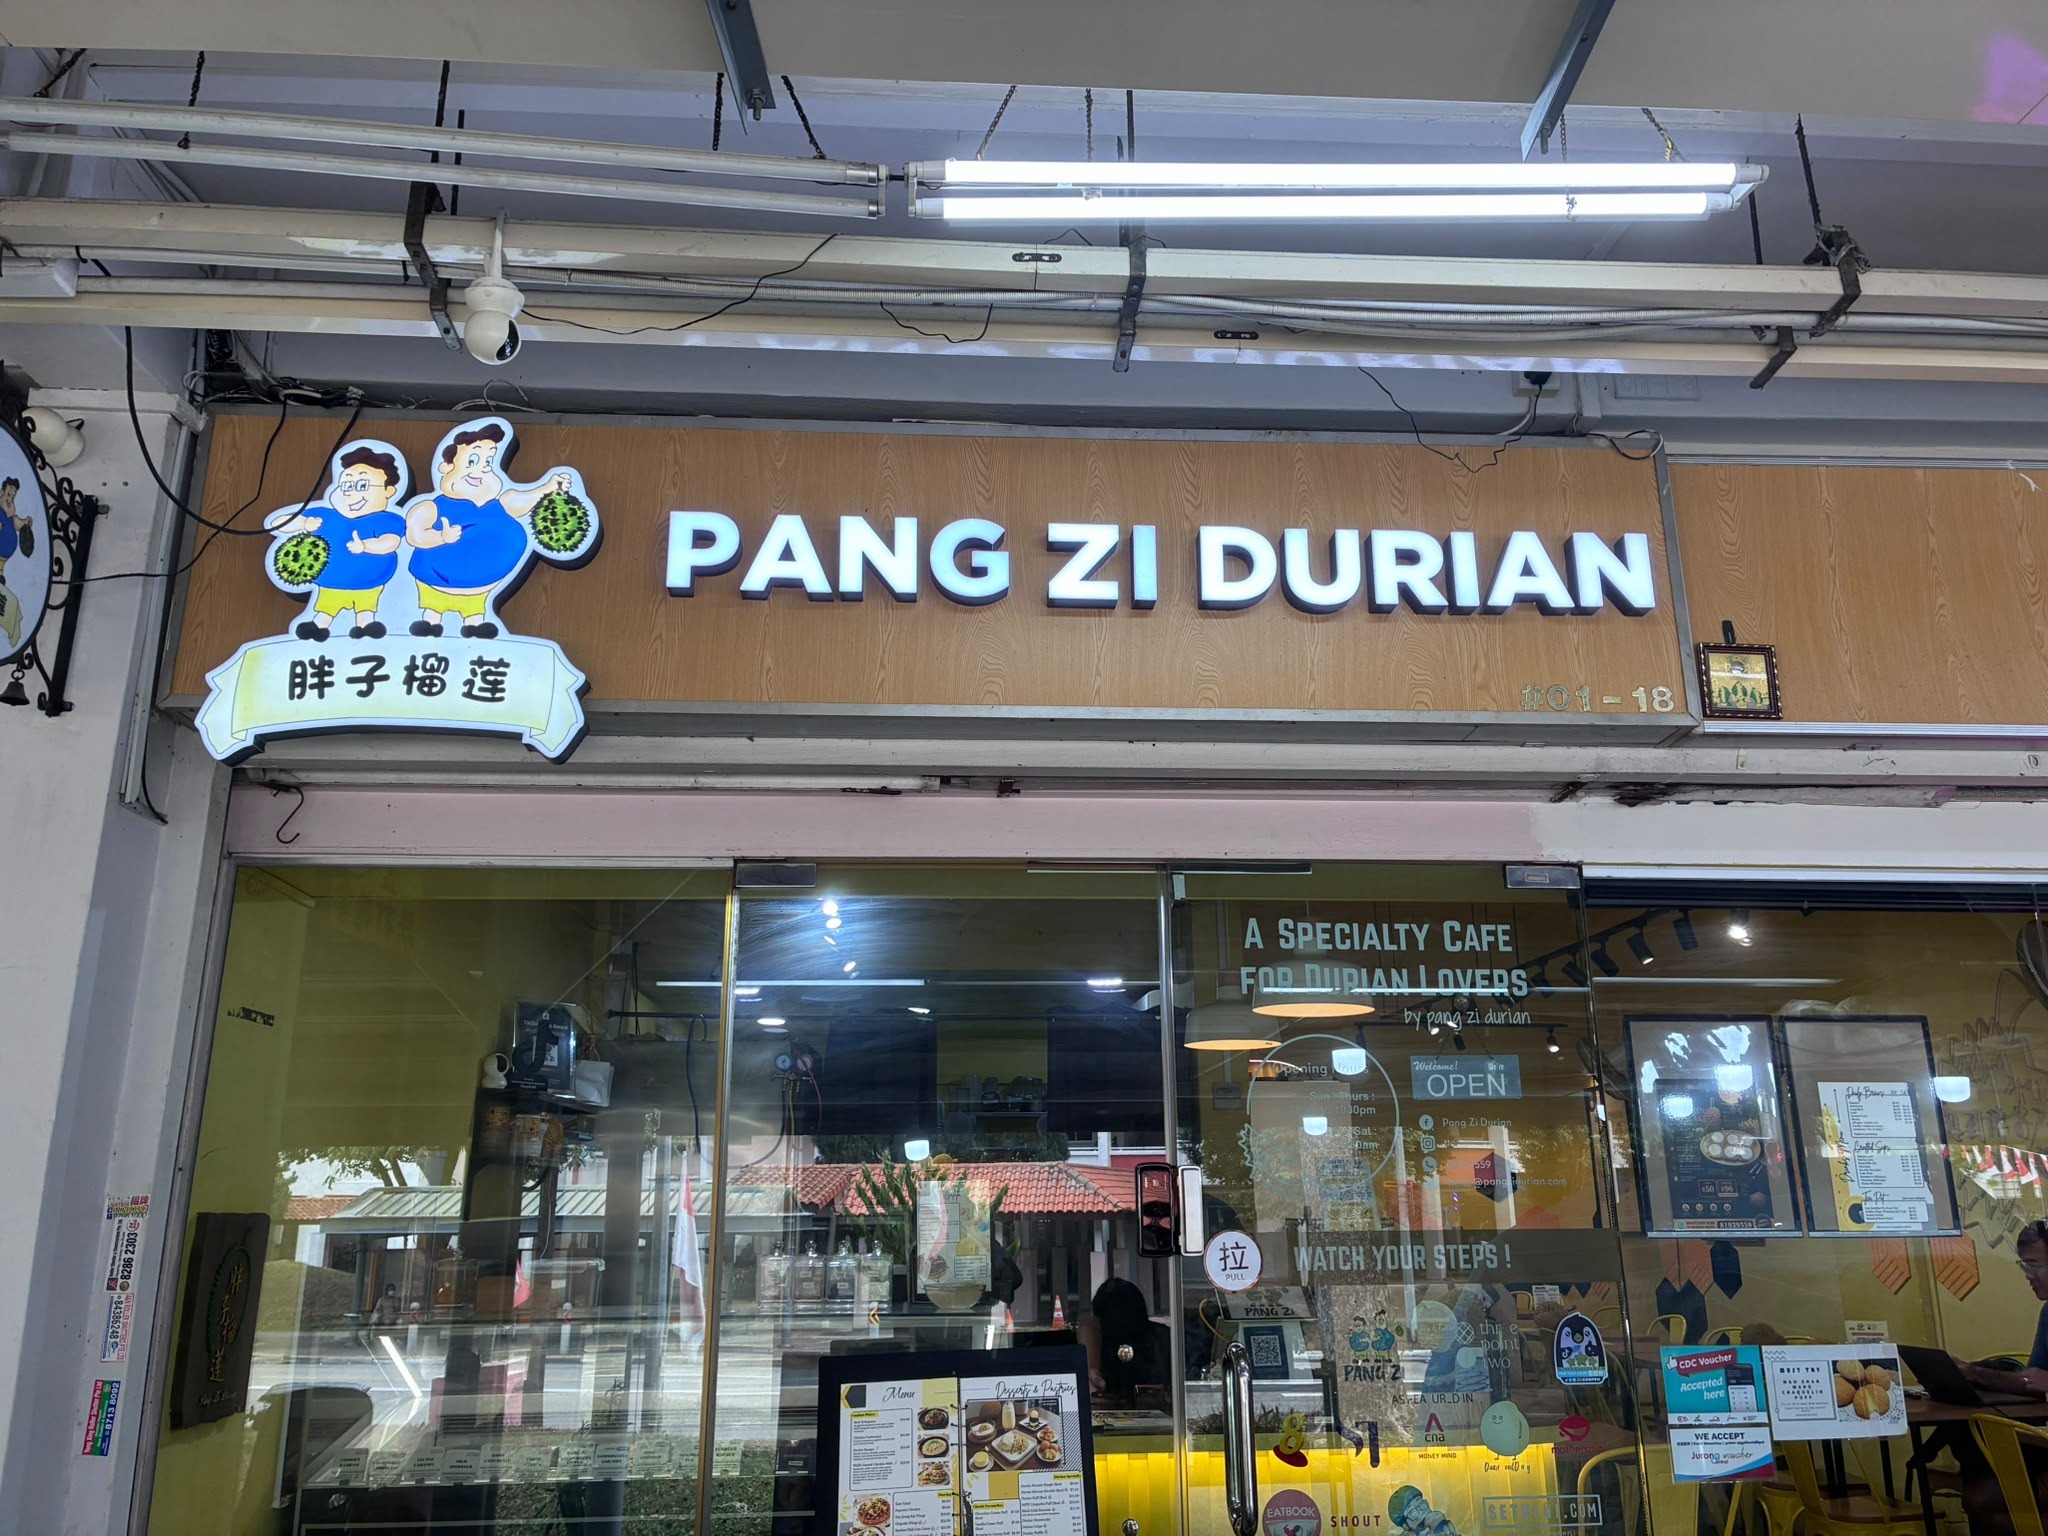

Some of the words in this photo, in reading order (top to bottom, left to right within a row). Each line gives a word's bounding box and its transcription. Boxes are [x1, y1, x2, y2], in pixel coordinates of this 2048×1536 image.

[666, 511, 1010, 604] PANG
[1047, 522, 1158, 609] ZI
[1196, 525, 1656, 616] DURIAN
[288, 652, 511, 703] 胖子榴莲
[1244, 917, 1264, 949] A
[1442, 920, 1513, 952] CAFE
[1404, 1009, 1421, 1031] by
[1427, 1011, 1463, 1031] pang
[1467, 1008, 1480, 1024] zi
[1484, 1008, 1530, 1024] durian
[1272, 1063, 1327, 1076] Opening
[1413, 1060, 1458, 1071] Welcome!
[1427, 1074, 1506, 1097] OPEN
[1443, 1118, 1466, 1128] Pang
[1469, 1118, 1478, 1127] Zi
[124, 1232, 138, 1255] 2303
[1219, 1241, 1249, 1272] 拉
[1294, 1246, 1365, 1271] WATCH
[1373, 1245, 1426, 1270] YOUR
[1434, 1244, 1498, 1269] STEPS
[120, 1257, 134, 1280] 8286
[1225, 1273, 1245, 1281] PULL
[110, 1300, 124, 1340] 84386248
[1244, 1307, 1279, 1317] PANG
[1480, 1320, 1519, 1335] thre
[1679, 1359, 1697, 1369] CDC
[1698, 1354, 1732, 1366] Voucher
[1344, 1364, 1386, 1382] PANG
[996, 1381, 1032, 1400] Desserts
[1041, 1379, 1076, 1398] Pastries
[1680, 1376, 1723, 1392] Accepted
[109, 1382, 120, 1405] 8092
[1392, 1395, 1405, 1405] AS
[1462, 1393, 1473, 1403] IN
[1704, 1389, 1725, 1400] here
[105, 1407, 115, 1430] 8713
[1425, 1433, 1445, 1442] cna
[1711, 1432, 1745, 1440] ACCEPT
[1691, 1451, 1720, 1461] Jurong
[1267, 1506, 1316, 1518] EATBOOK
[1330, 1515, 1381, 1527] SHOUT
